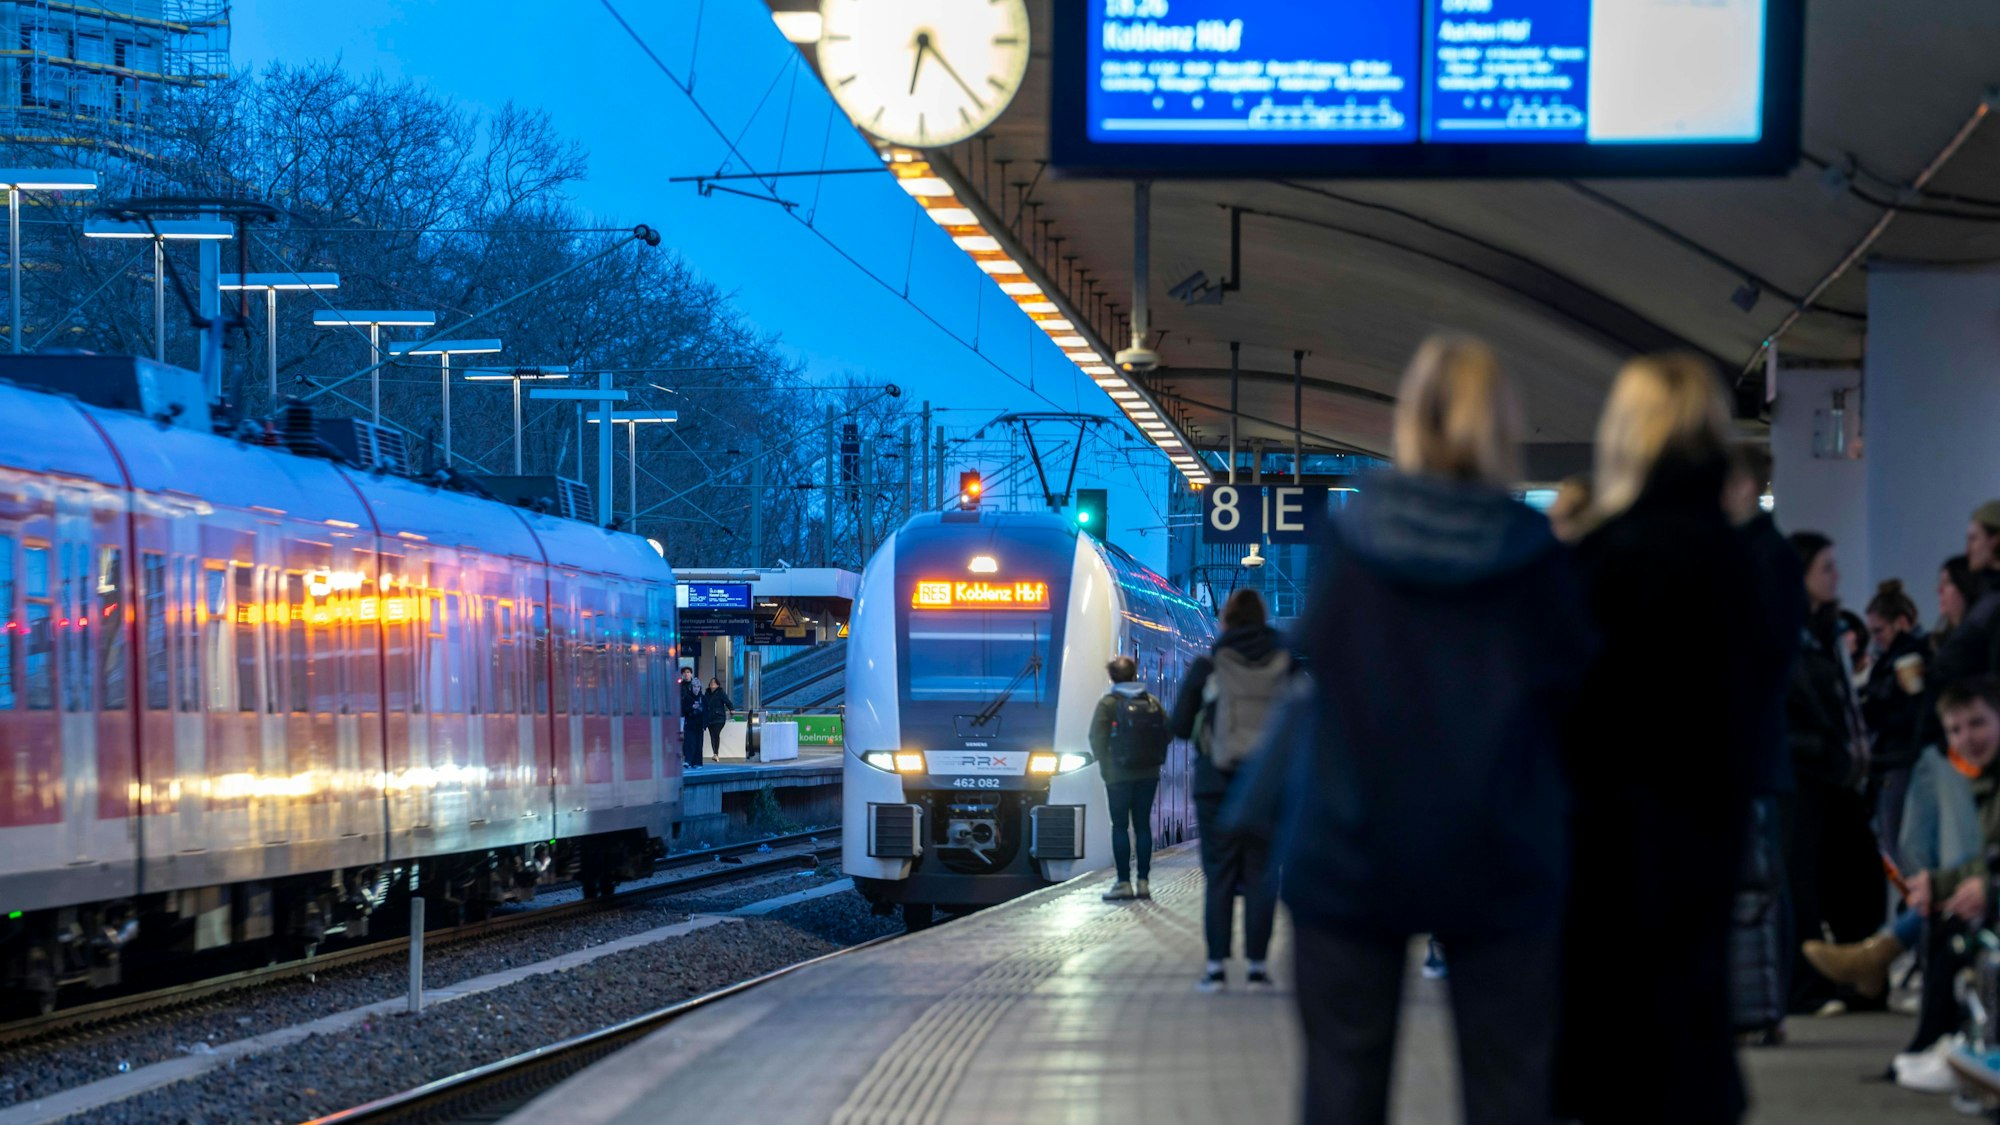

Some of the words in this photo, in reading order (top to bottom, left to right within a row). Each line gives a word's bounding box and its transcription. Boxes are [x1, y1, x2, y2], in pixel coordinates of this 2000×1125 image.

[1211, 486, 1240, 531] 8
[1276, 487, 1304, 531] E
[921, 583, 949, 602] RE5
[955, 581, 1013, 602] Koblenz
[1015, 581, 1043, 602] Hbf
[962, 756, 1007, 767] RRX
[953, 778, 975, 788] 462
[978, 778, 1000, 788] 082
